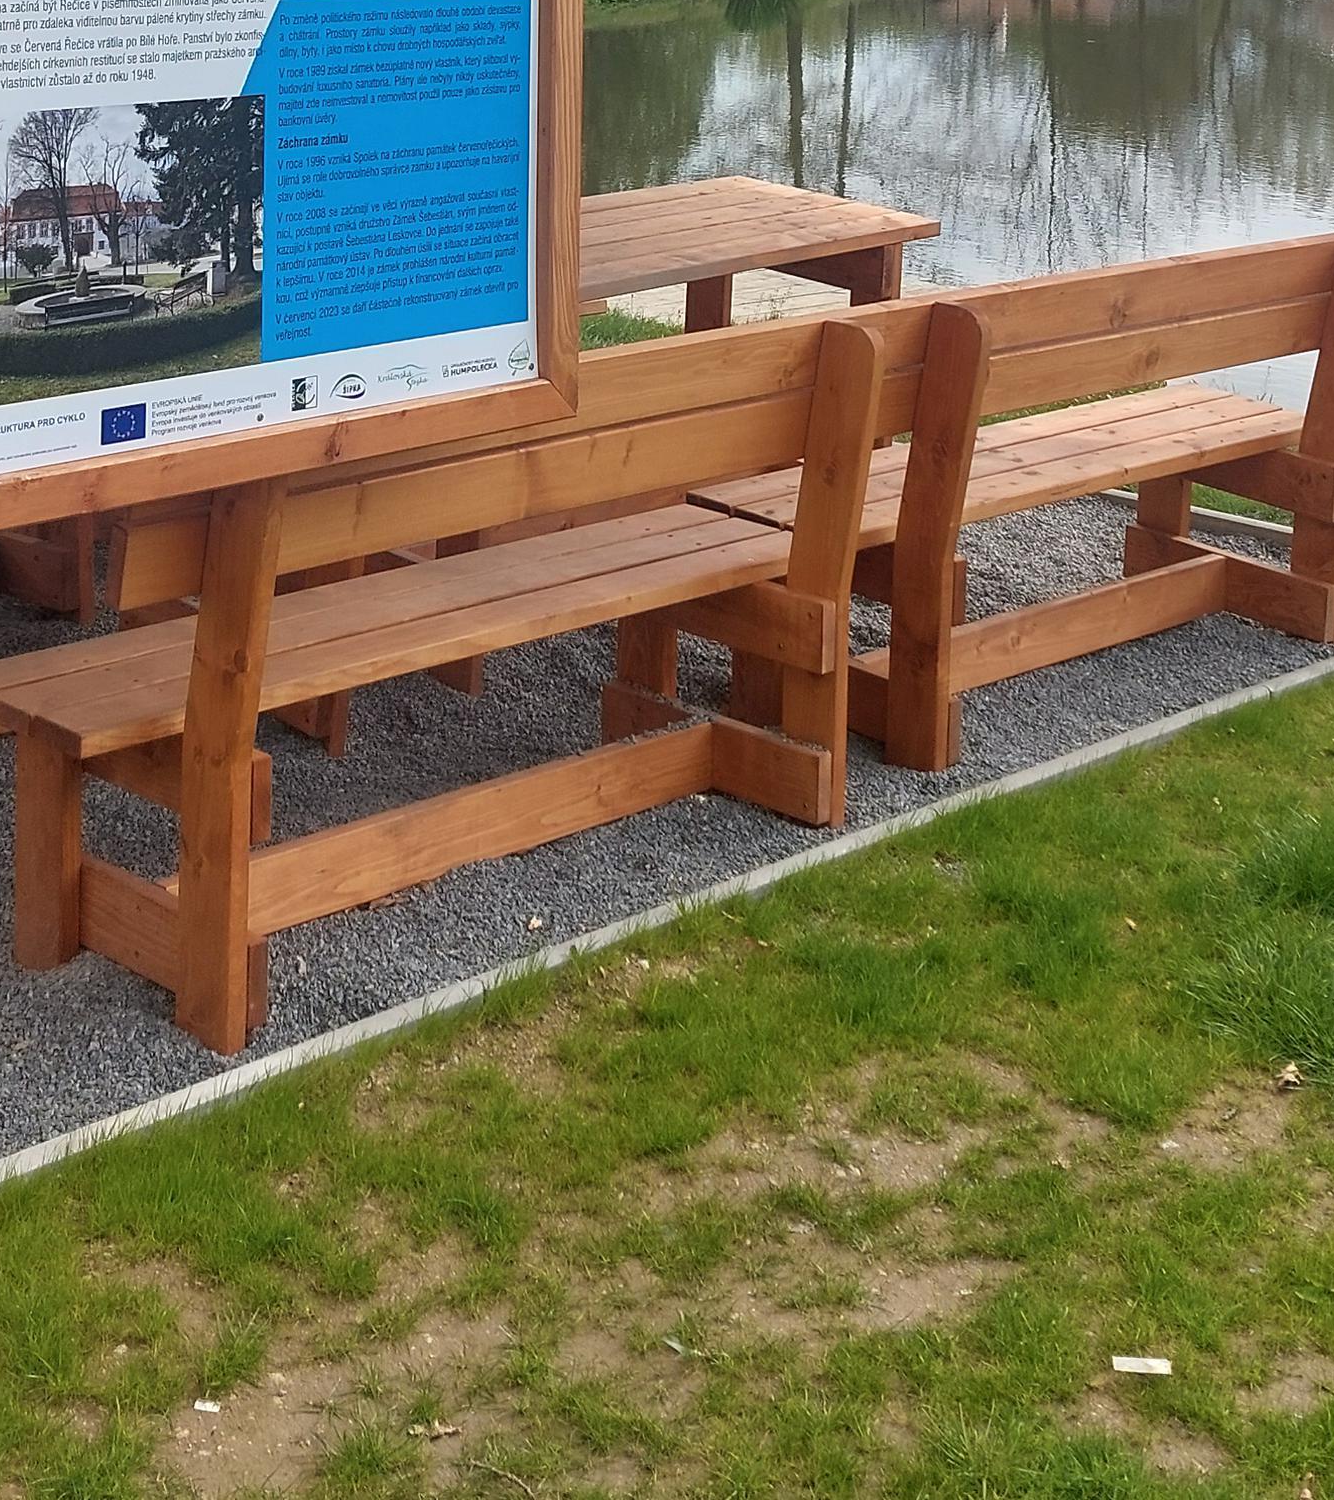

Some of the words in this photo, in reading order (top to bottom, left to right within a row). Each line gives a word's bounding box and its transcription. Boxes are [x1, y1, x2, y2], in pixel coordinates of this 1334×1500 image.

[10, 0, 39, 12] začíná
[42, 0, 57, 13] být
[40, 16, 74, 29] zdaleka
[120, 14, 144, 25] barvu
[205, 9, 235, 23] střechy
[24, 39, 61, 52] Červená
[64, 37, 94, 50] Řečice
[97, 36, 123, 49] vrátila
[139, 51, 160, 63] stalo
[0, 75, 45, 89] vlastnictví
[48, 73, 80, 86] zůstalo
[109, 71, 128, 83] roku
[278, 137, 318, 148] Záchrana
[320, 134, 348, 144] zámku
[57, 412, 86, 424] CYKLO
